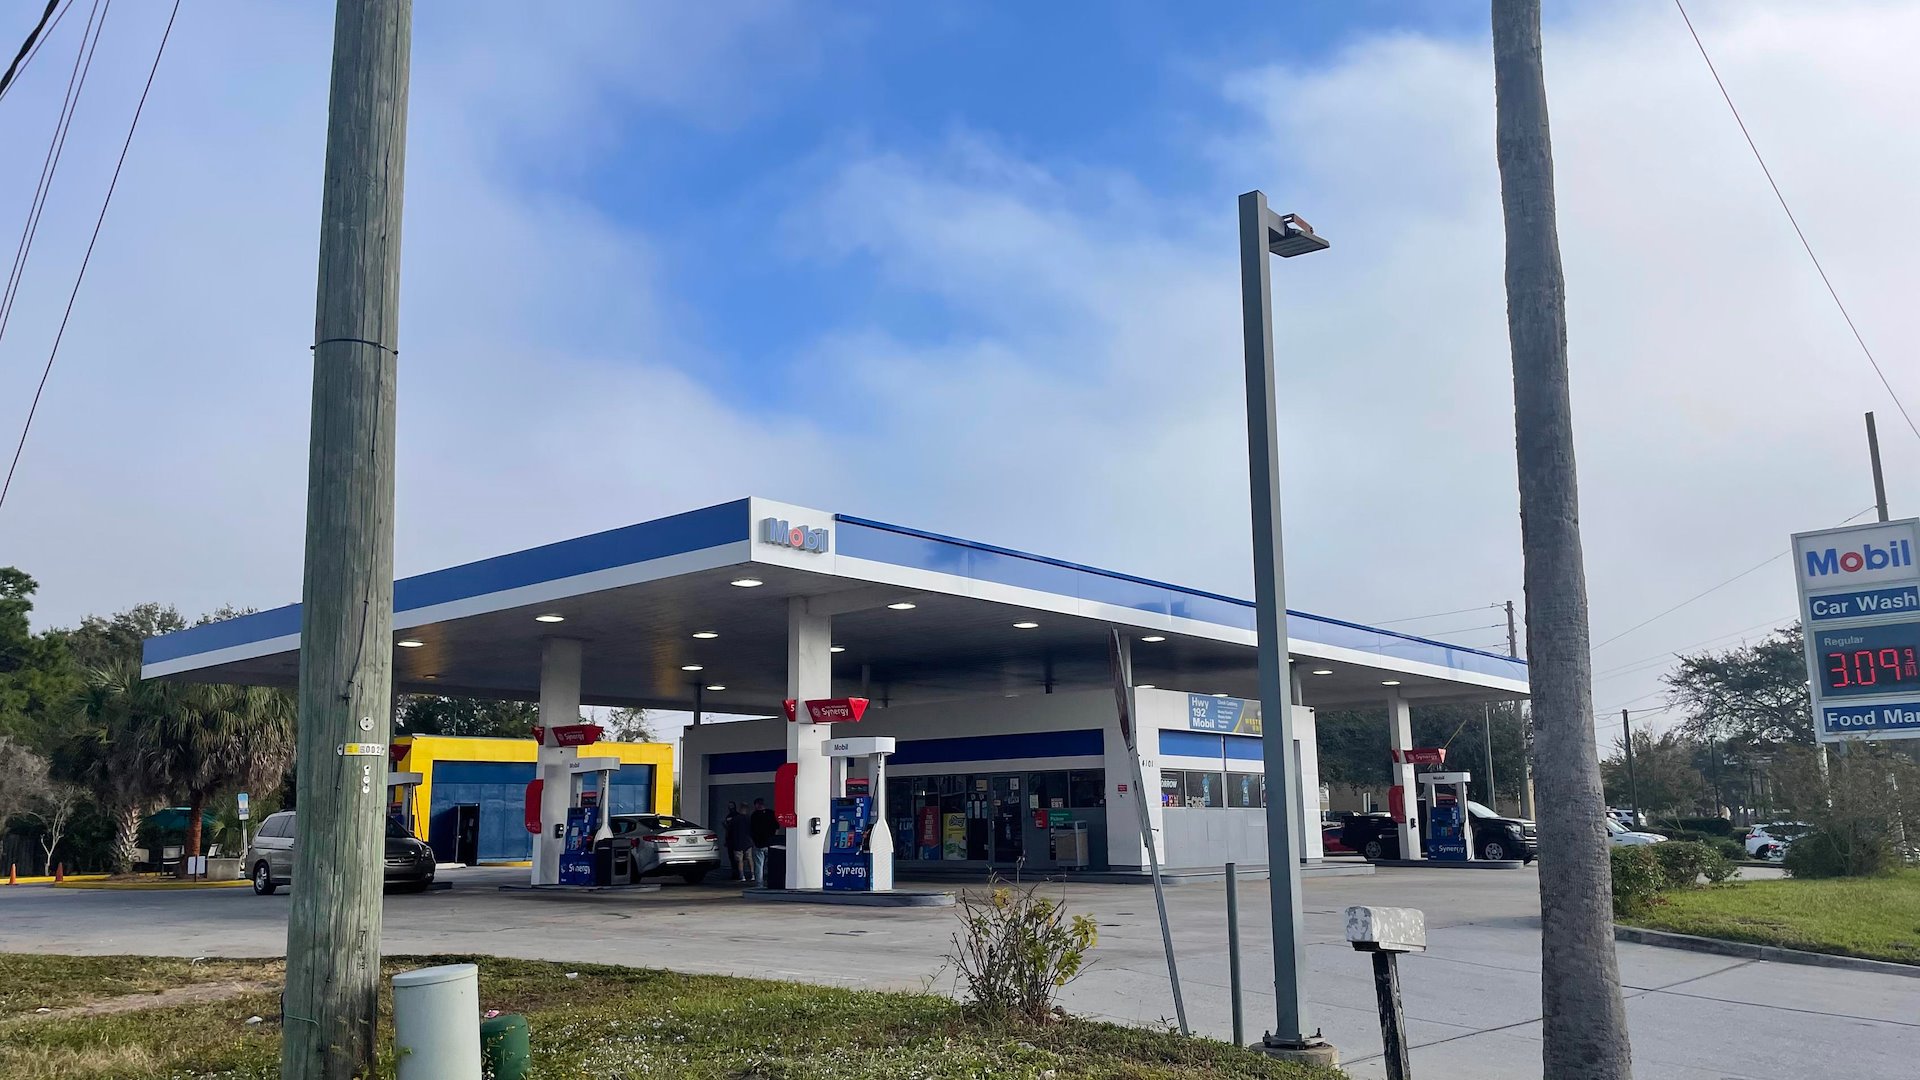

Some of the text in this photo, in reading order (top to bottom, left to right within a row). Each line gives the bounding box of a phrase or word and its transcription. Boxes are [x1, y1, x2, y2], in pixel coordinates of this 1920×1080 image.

[764, 518, 829, 552] Mobil
[1806, 540, 1911, 576] Mobil
[1813, 592, 1918, 616] Car Wash
[1824, 636, 1864, 647] Regular
[790, 704, 795, 712] 5
[1191, 697, 1209, 708] Hwy
[821, 707, 849, 717] Synergy
[1193, 708, 1206, 717] 192
[1193, 718, 1215, 728] Mobil
[1827, 710, 1876, 727] Food
[1438, 844, 1465, 854] Synergy
[836, 864, 867, 878] Synergy
